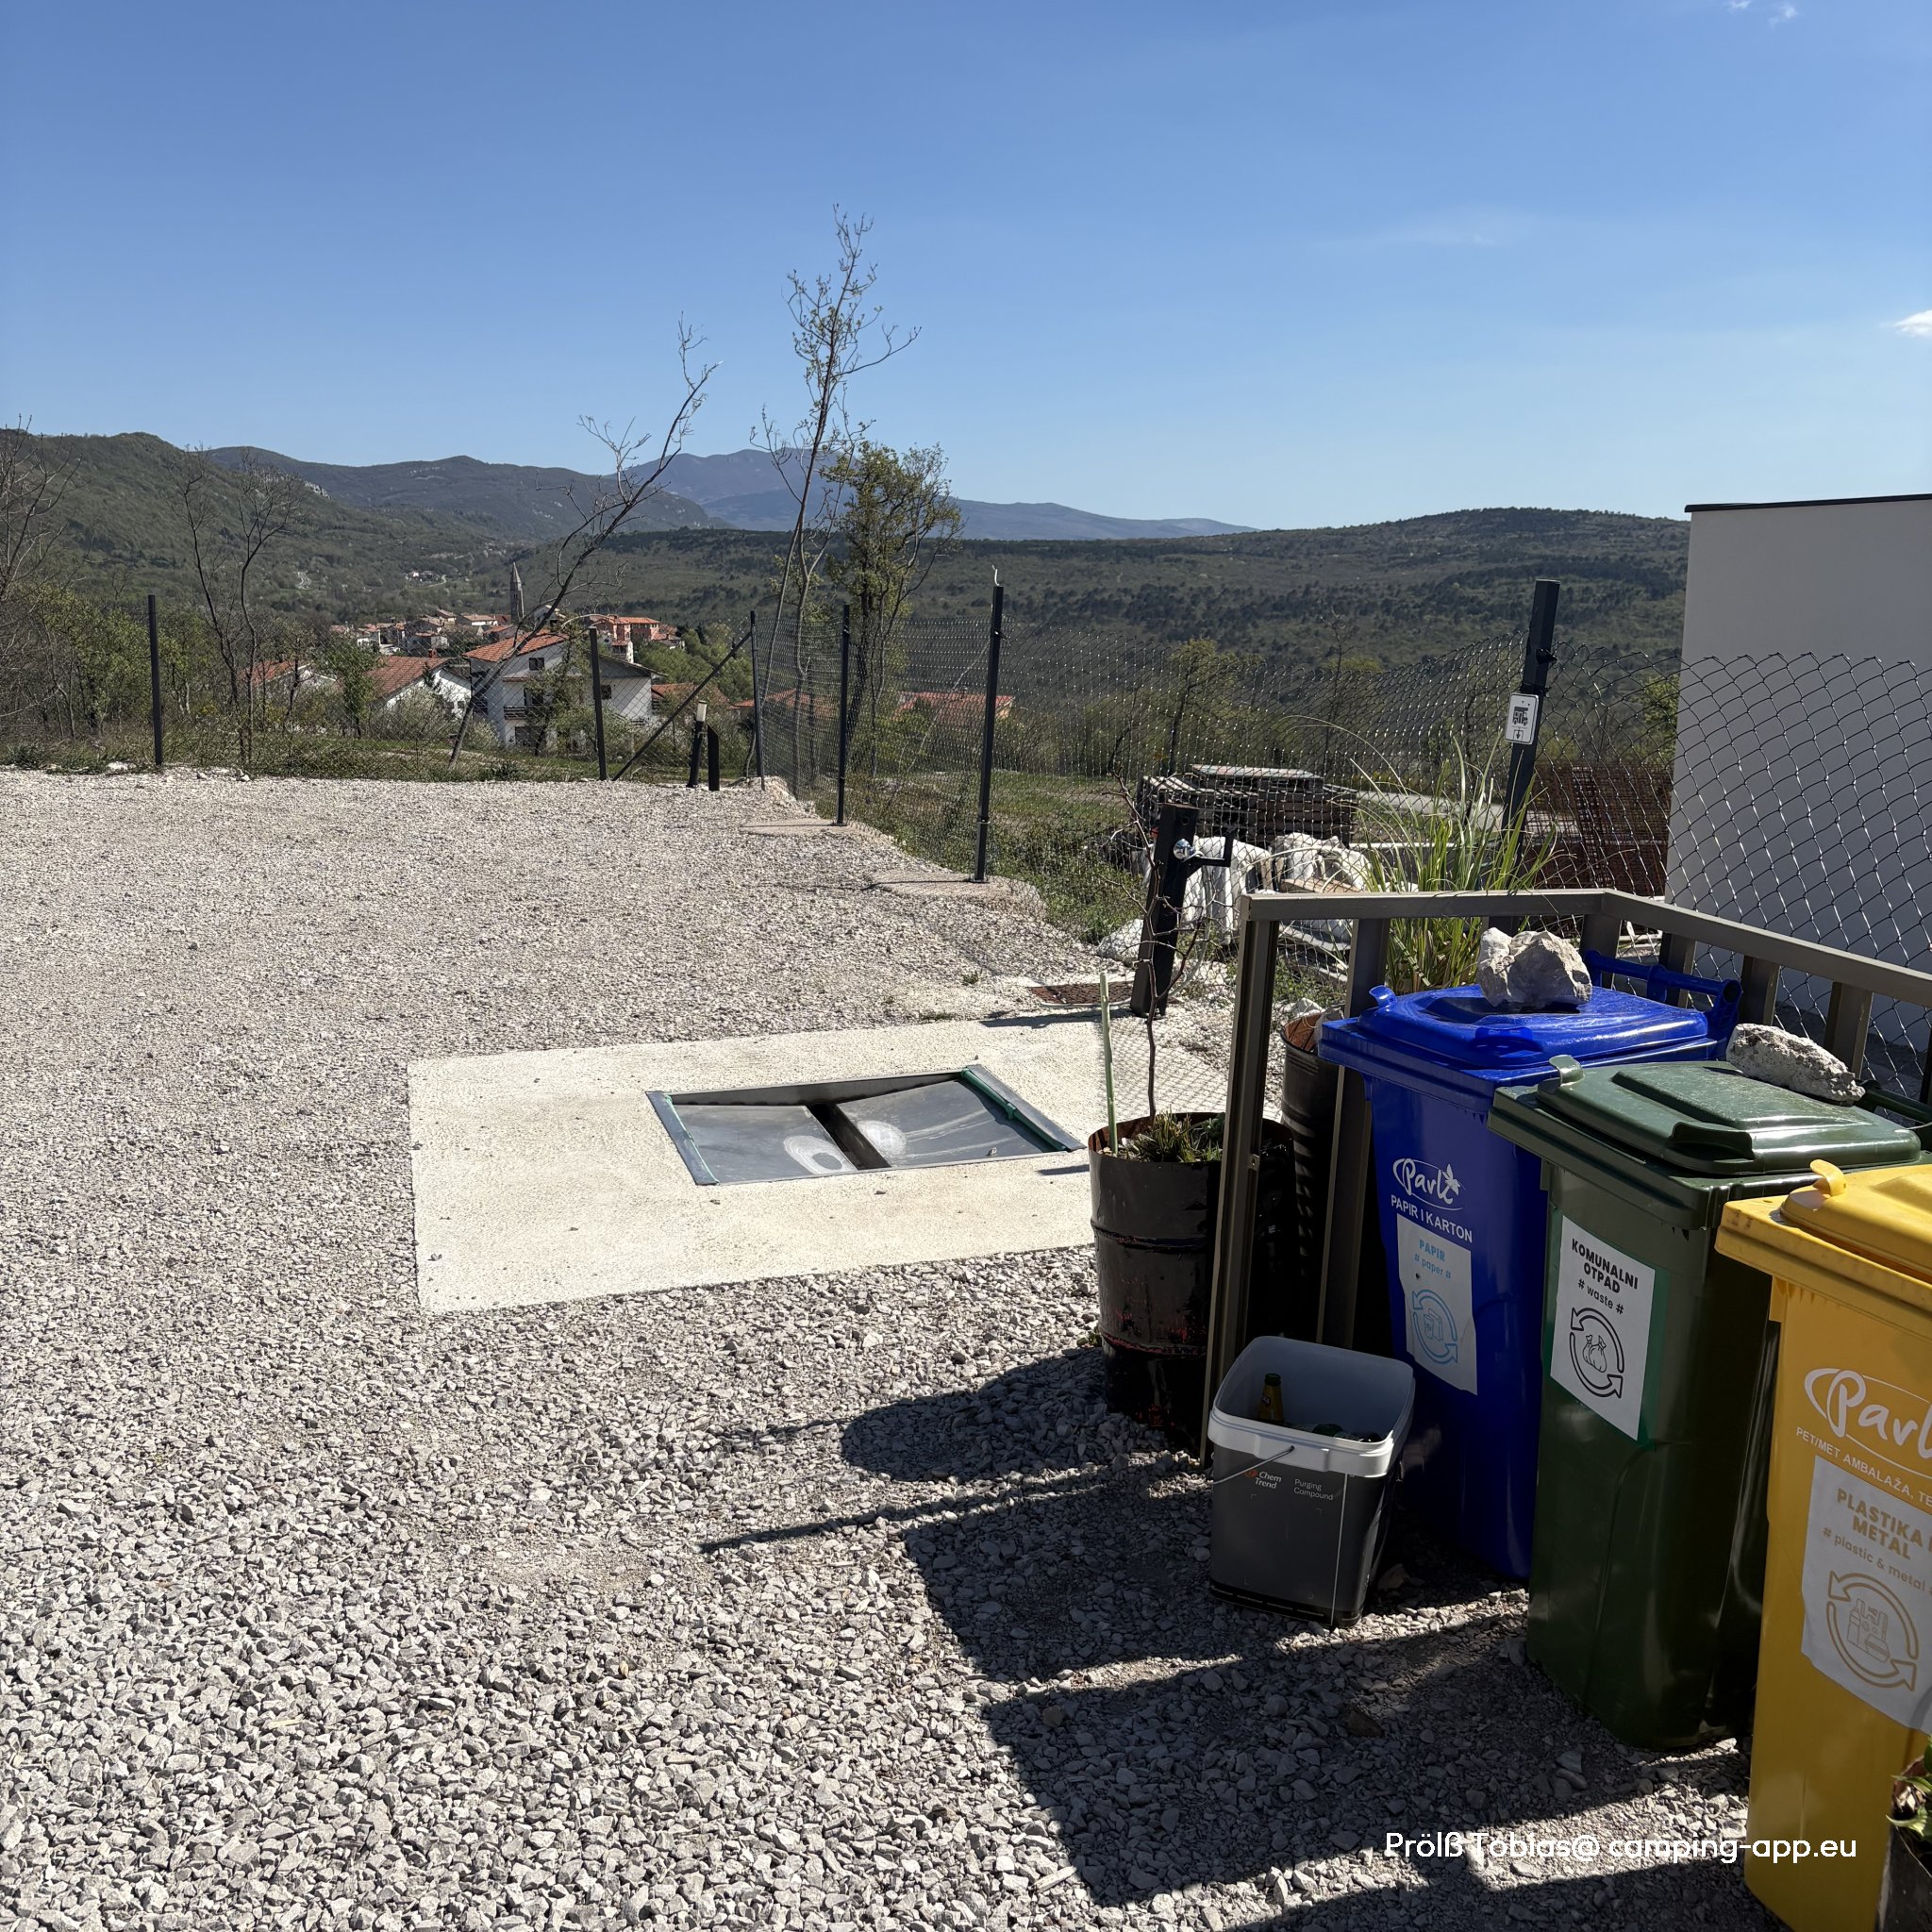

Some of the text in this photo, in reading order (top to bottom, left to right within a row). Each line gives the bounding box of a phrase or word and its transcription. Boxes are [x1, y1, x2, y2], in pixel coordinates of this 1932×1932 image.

[1391, 1193, 1473, 1243] PAPIR I KARTON
[1419, 1238, 1445, 1262] PAPIR
[1422, 1257, 1443, 1276] paper
[1572, 1238, 1639, 1291] KOMUNALNI
[1583, 1262, 1621, 1293] OTPAD
[1577, 1278, 1624, 1315] # waste #
[1258, 1471, 1283, 1483] Chem
[1796, 1426, 1841, 1458] PET/MET
[1843, 1454, 1914, 1500] AMBALAŽA,
[1255, 1476, 1278, 1490] Trend
[1293, 1487, 1334, 1501] Compound
[1294, 1478, 1322, 1491] Purging
[1837, 1488, 1924, 1547] PLASTIKA
[1852, 1515, 1911, 1560] METAL
[1834, 1534, 1874, 1563] plastic
[1875, 1557, 1886, 1571] &
[1889, 1565, 1926, 1591] metal
